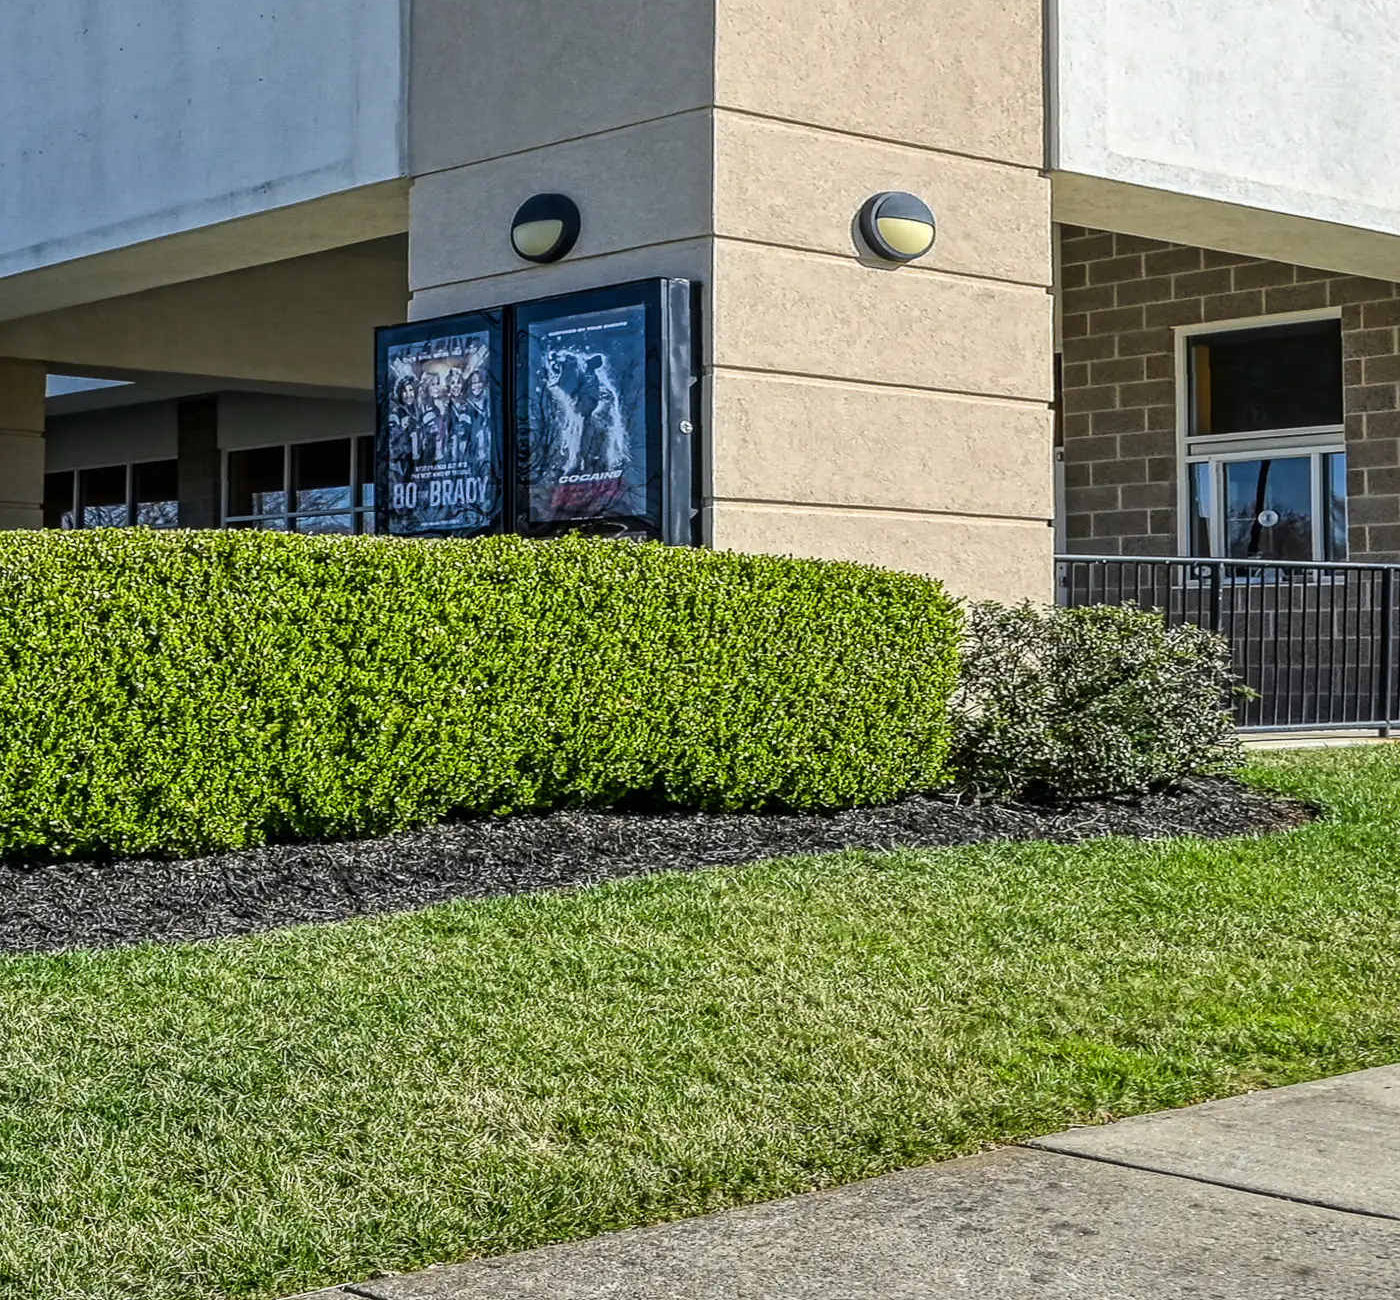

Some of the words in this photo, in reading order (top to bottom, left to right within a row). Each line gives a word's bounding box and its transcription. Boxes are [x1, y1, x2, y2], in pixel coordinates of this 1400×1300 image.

[558, 469, 623, 484] COCAINE
[393, 482, 417, 509] 80
[429, 476, 488, 507] BRADY
